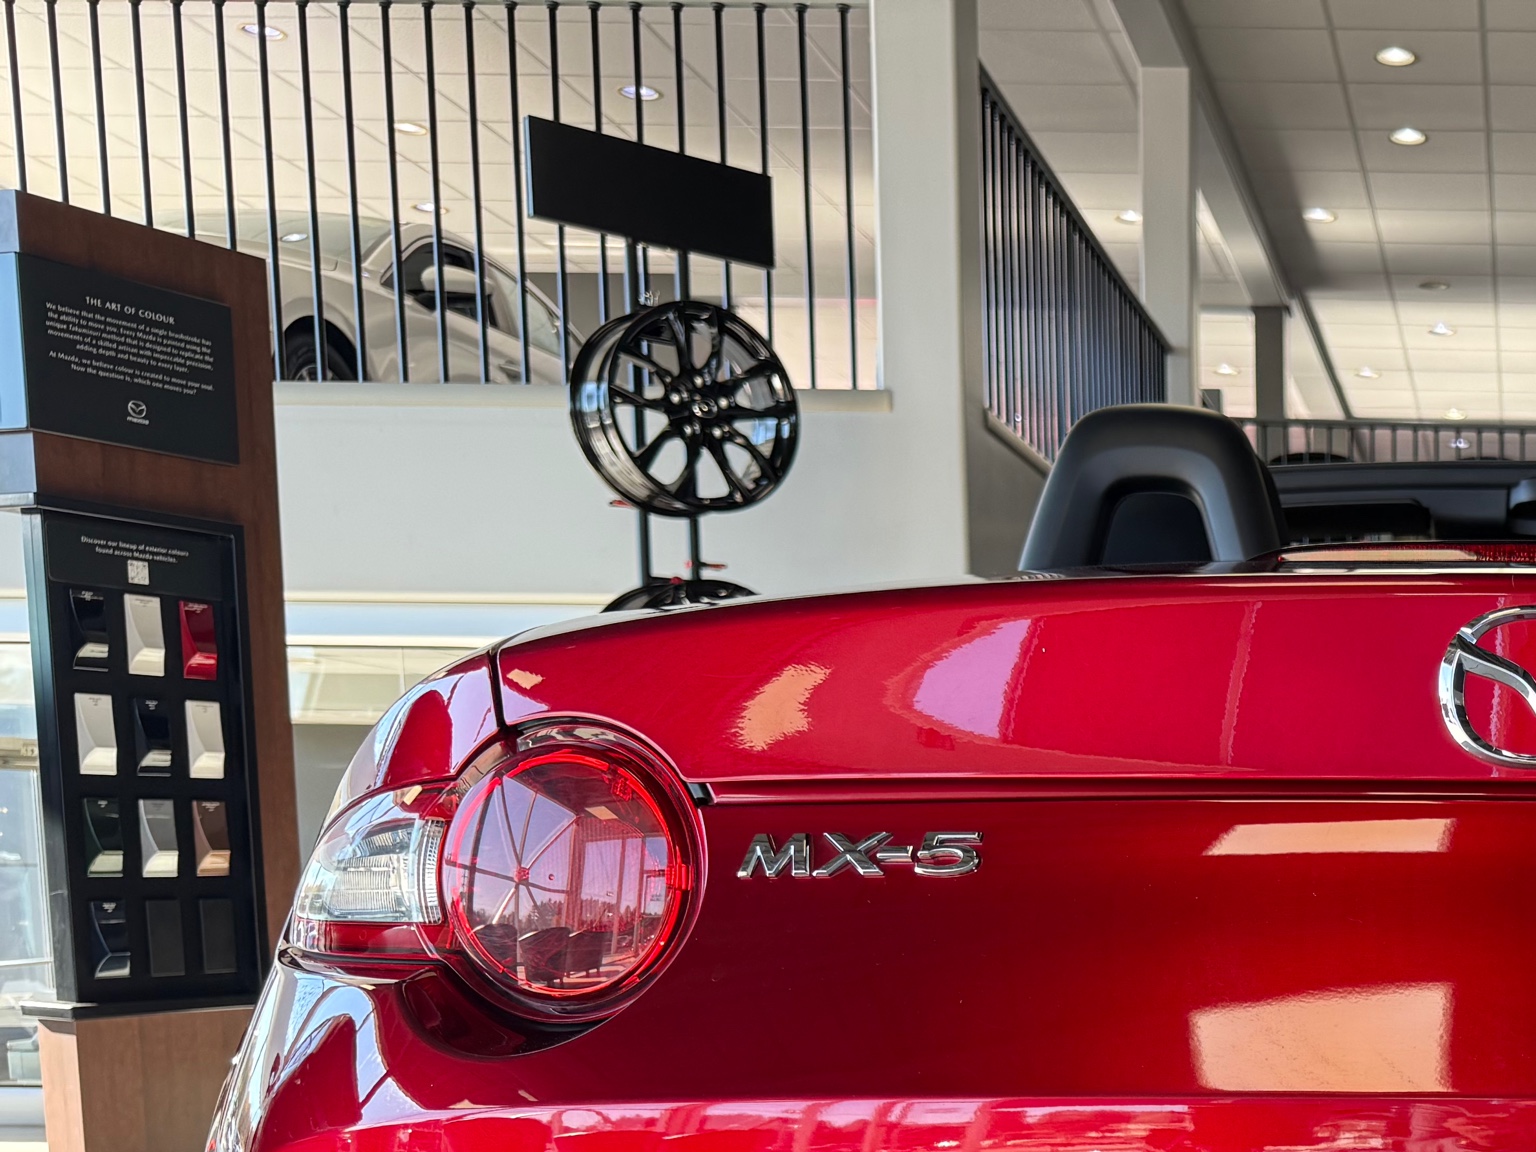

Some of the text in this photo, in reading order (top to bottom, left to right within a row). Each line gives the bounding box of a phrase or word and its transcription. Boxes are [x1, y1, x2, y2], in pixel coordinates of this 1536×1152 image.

[58, 304, 80, 316] believe
[81, 310, 94, 319] that
[95, 313, 105, 322] the
[106, 316, 137, 329] movement
[151, 326, 167, 336] single
[202, 338, 211, 347] has
[86, 296, 175, 325] THE ART OF COLOUR
[46, 319, 67, 330] unique
[102, 332, 125, 343] method
[126, 337, 137, 346] that
[145, 342, 171, 354] designed
[180, 350, 203, 361] replicate
[205, 356, 214, 364] the
[48, 311, 58, 319] the
[60, 314, 79, 324] ability
[88, 320, 105, 330] move
[121, 328, 135, 337] Every
[137, 332, 156, 342] Mazda
[164, 338, 185, 349] painted
[202, 347, 211, 355] the
[48, 327, 83, 342] movements
[98, 339, 117, 350] skilled
[118, 344, 138, 355] artisan
[139, 349, 152, 358] with
[153, 352, 185, 366] impeccable
[58, 352, 80, 363] Mazda,
[92, 359, 113, 371] believe
[115, 364, 134, 375] colour
[141, 370, 162, 381] created
[171, 377, 186, 386] move
[188, 380, 200, 389] your
[76, 342, 97, 354] adding
[98, 347, 116, 358] depth
[118, 351, 129, 361] and
[130, 354, 149, 365] beauty
[158, 360, 173, 370] every
[71, 363, 86, 372] Now
[87, 366, 96, 374] the
[98, 369, 124, 381] question
[134, 376, 150, 386] which
[152, 380, 163, 389] one
[164, 383, 182, 393] moves
[183, 387, 196, 396] you?
[81, 536, 106, 546] Discover
[108, 539, 118, 547] our
[119, 541, 137, 550] lineup
[146, 545, 167, 554] exterior
[96, 546, 113, 555] found
[114, 548, 132, 557] across
[133, 551, 153, 560] Mazda
[736, 831, 983, 878] MX-5
